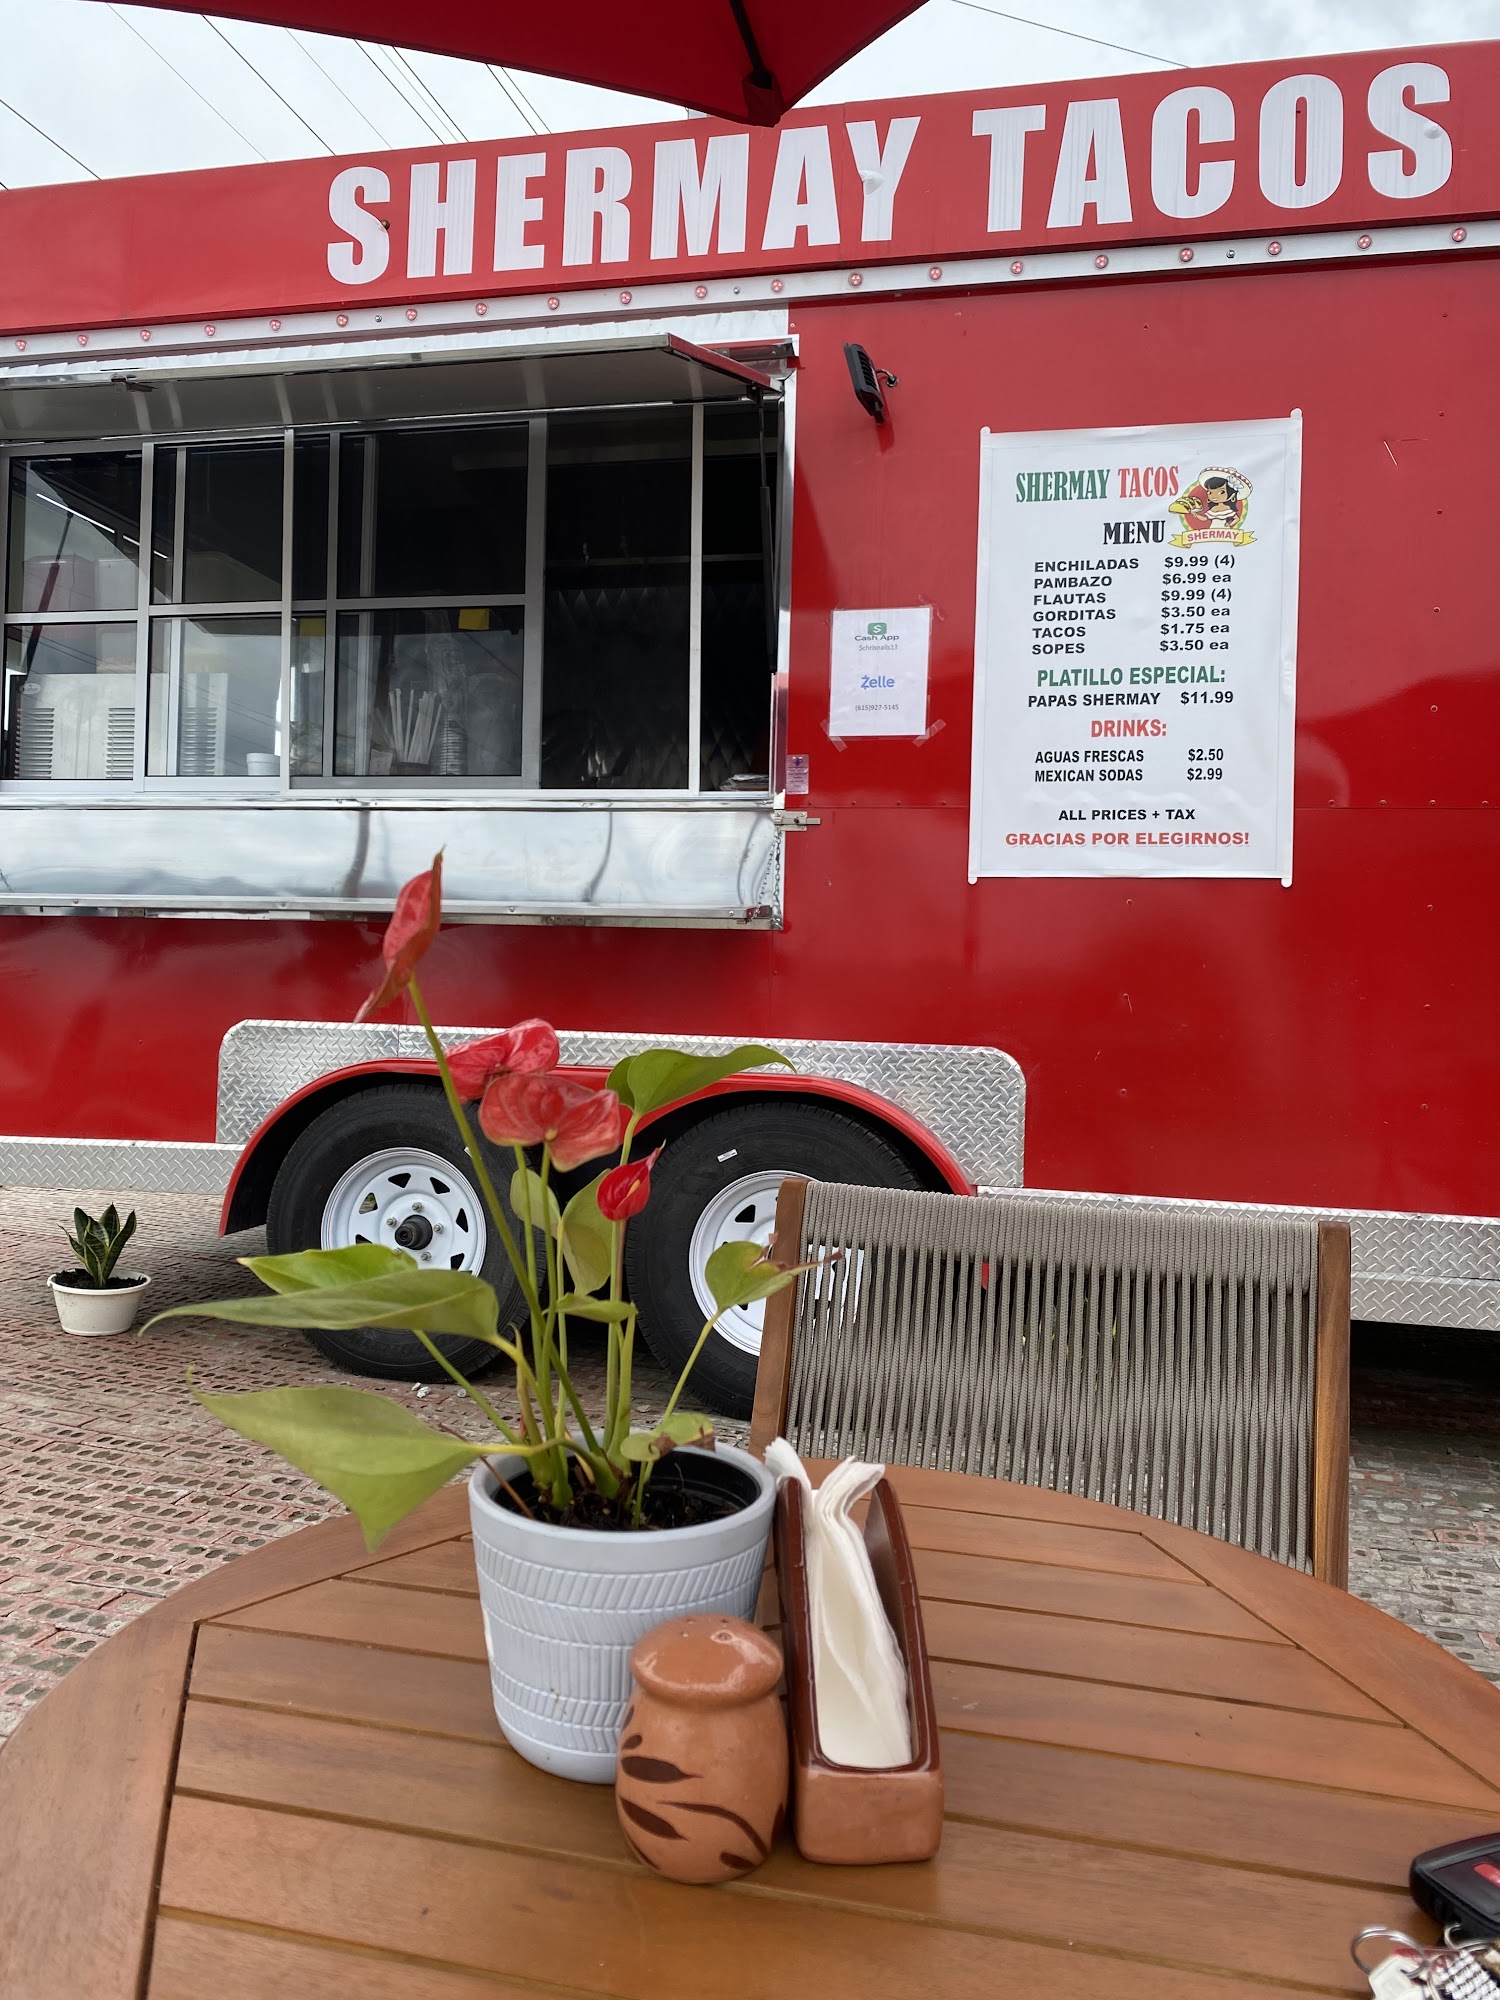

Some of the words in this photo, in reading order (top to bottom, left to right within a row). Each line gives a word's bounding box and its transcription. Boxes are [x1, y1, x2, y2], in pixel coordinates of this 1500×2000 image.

[327, 116, 921, 285] SHERMAY
[972, 62, 1452, 233] TACOS
[1016, 469, 1110, 503] SHERMAY
[1118, 466, 1179, 498] TACOS
[1103, 520, 1165, 545] MENU
[1187, 530, 1240, 542] SHERMAY
[1034, 558, 1139, 572] ENCHILADAS
[1164, 556, 1209, 568] $9.99
[1214, 555, 1235, 569] (4)
[1034, 576, 1112, 589] PAMBAZO
[1162, 572, 1206, 585] $6.99
[1212, 574, 1231, 583] ea
[1033, 592, 1106, 605] FLAUTAS
[1161, 589, 1205, 602] $9.99
[1211, 588, 1232, 602] (4)
[1033, 609, 1116, 622] GORDITAS
[1161, 606, 1205, 619] $3.50
[1211, 607, 1230, 616] ea
[1032, 626, 1086, 638] TACOS
[1160, 623, 1205, 636] $1.75
[1210, 624, 1230, 633] ea
[1032, 643, 1085, 655] SOPES
[1160, 639, 1204, 652] $3.50
[1209, 641, 1229, 650] ea
[861, 675, 895, 690] Zelle
[1037, 667, 1123, 687] PLATILLO
[1129, 665, 1225, 684] ESPECIAL:
[1028, 694, 1077, 707] PAPAS
[1082, 692, 1161, 706] SHERMAY
[1180, 691, 1234, 705] $11.99
[1091, 718, 1167, 737] DRINKS:
[1035, 751, 1079, 763] AGUAS
[1084, 749, 1144, 762] FRESCAS
[1188, 748, 1224, 762] $2.50
[1034, 769, 1094, 782] MEXICAN
[1099, 768, 1143, 781] SODAS
[1187, 767, 1223, 781] $2.99
[1058, 809, 1087, 821] ALL
[1091, 809, 1147, 820] PRICES
[1152, 811, 1160, 819] +
[1165, 809, 1195, 820] TAX
[1005, 833, 1086, 845] GRACIAS
[1091, 832, 1129, 845] POR
[1135, 832, 1250, 845] ELEGIRNOS!
